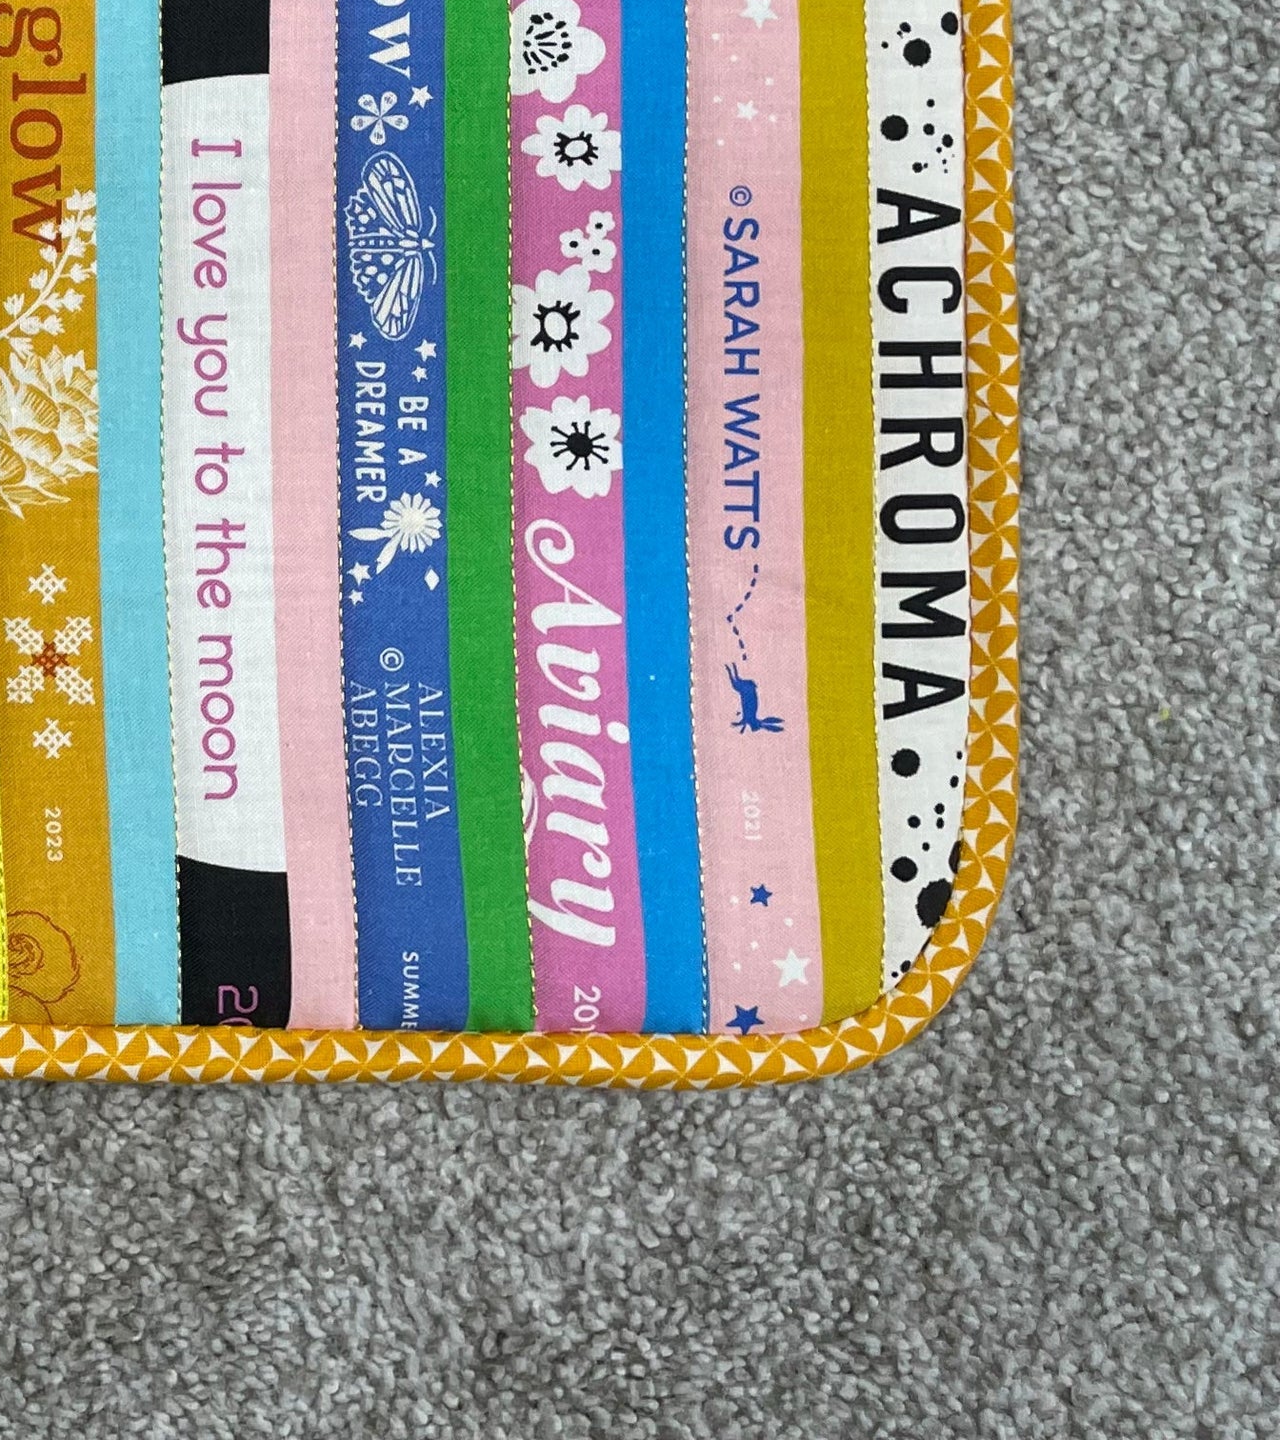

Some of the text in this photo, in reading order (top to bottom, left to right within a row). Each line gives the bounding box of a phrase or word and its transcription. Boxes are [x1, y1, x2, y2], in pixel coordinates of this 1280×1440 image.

[721, 217, 760, 377] SARAH
[178, 139, 246, 800] I love you to the moon
[355, 362, 386, 502] DREAMER
[399, 396, 428, 465] BE A
[723, 394, 761, 551] WATTS
[876, 188, 962, 721] ACHROMA
[350, 681, 381, 808] ABEGG
[386, 683, 422, 886] MARCELLE
[418, 683, 450, 821] ALEXIA
[525, 518, 629, 946] Aviary
[44, 807, 62, 861] 2023
[741, 790, 762, 841] 2021
